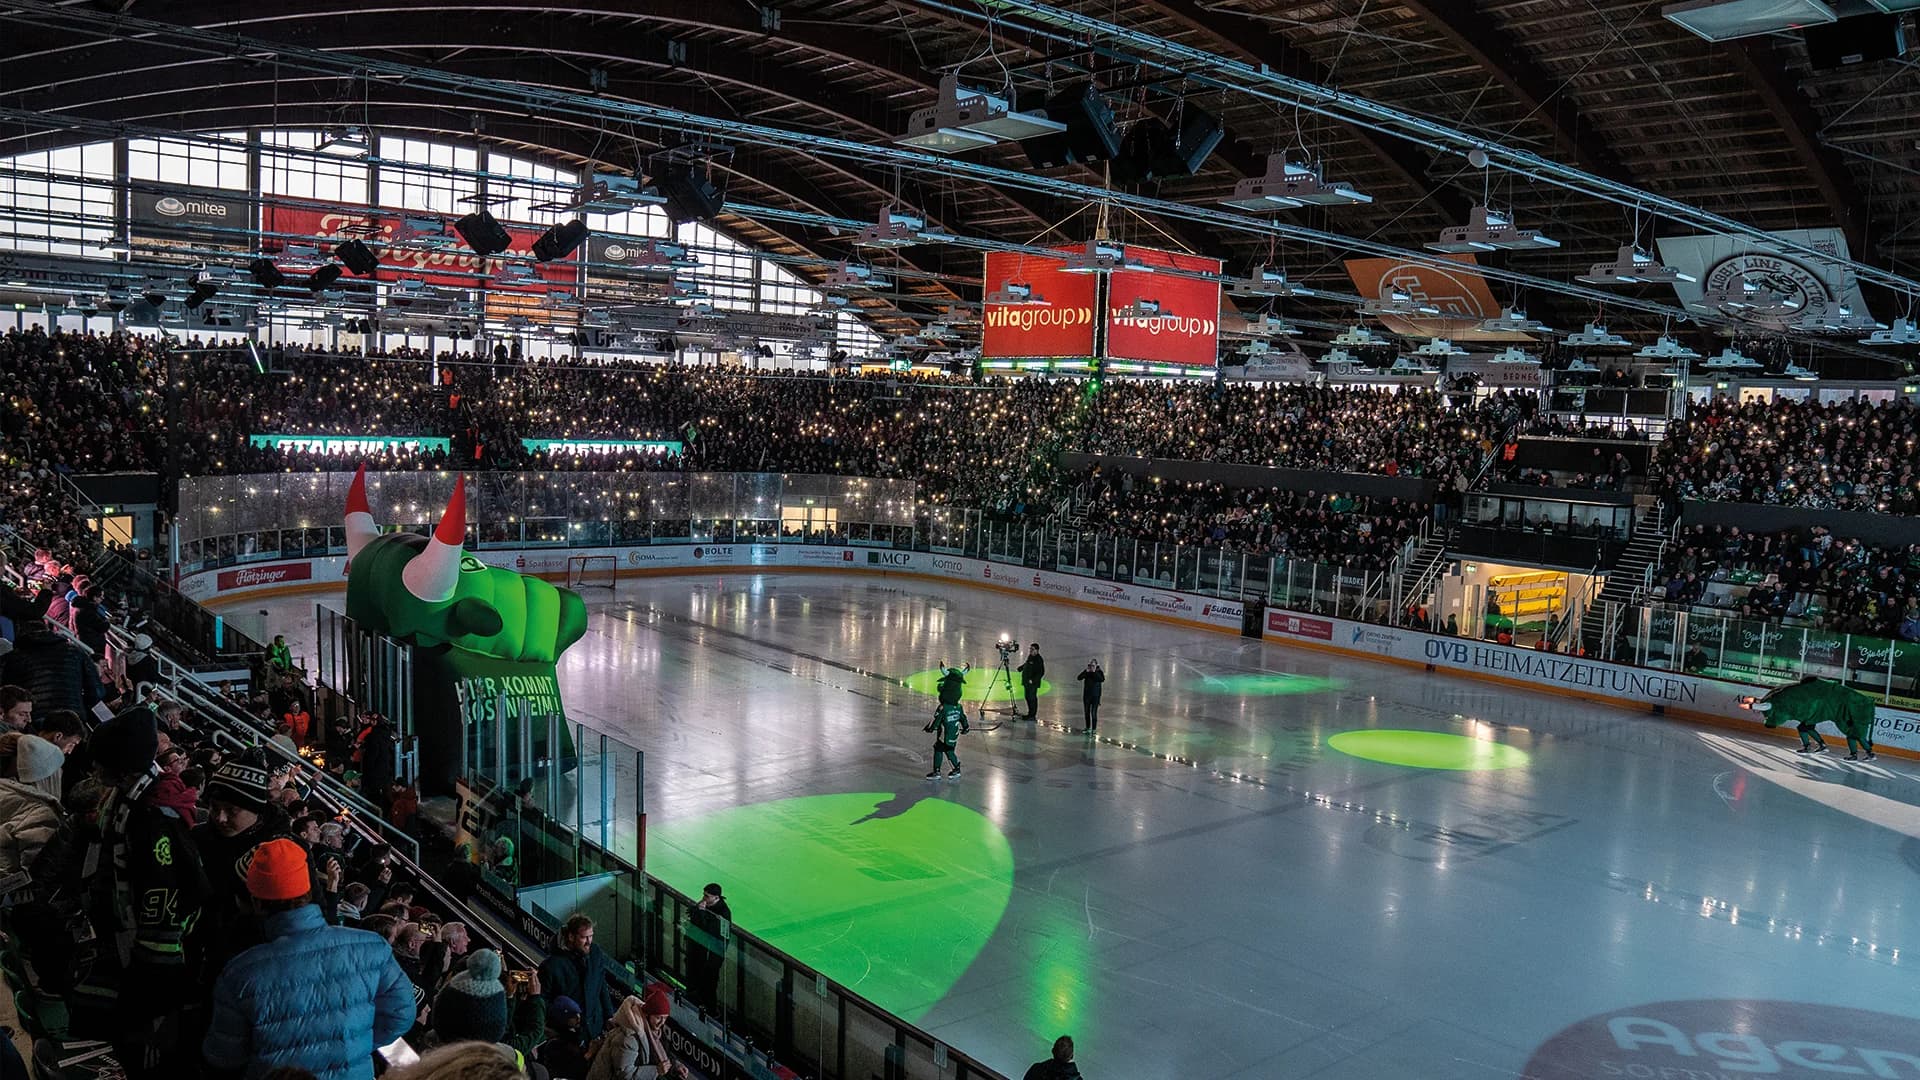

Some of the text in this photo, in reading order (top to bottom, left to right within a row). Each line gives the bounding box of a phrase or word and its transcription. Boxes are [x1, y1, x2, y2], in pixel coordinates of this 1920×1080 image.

[186, 200, 227, 217] mitea
[986, 305, 1076, 331] vitagroup
[705, 547, 733, 555] BOLTE
[882, 552, 910, 565] MCP
[528, 559, 564, 569] Sparkasse
[932, 556, 962, 571] komro
[236, 569, 287, 585] Flötzinger
[1424, 639, 1699, 703] OVB HEIMATZEITUNGEN
[501, 675, 555, 696] KOMMT
[221, 765, 266, 785] BULLS
